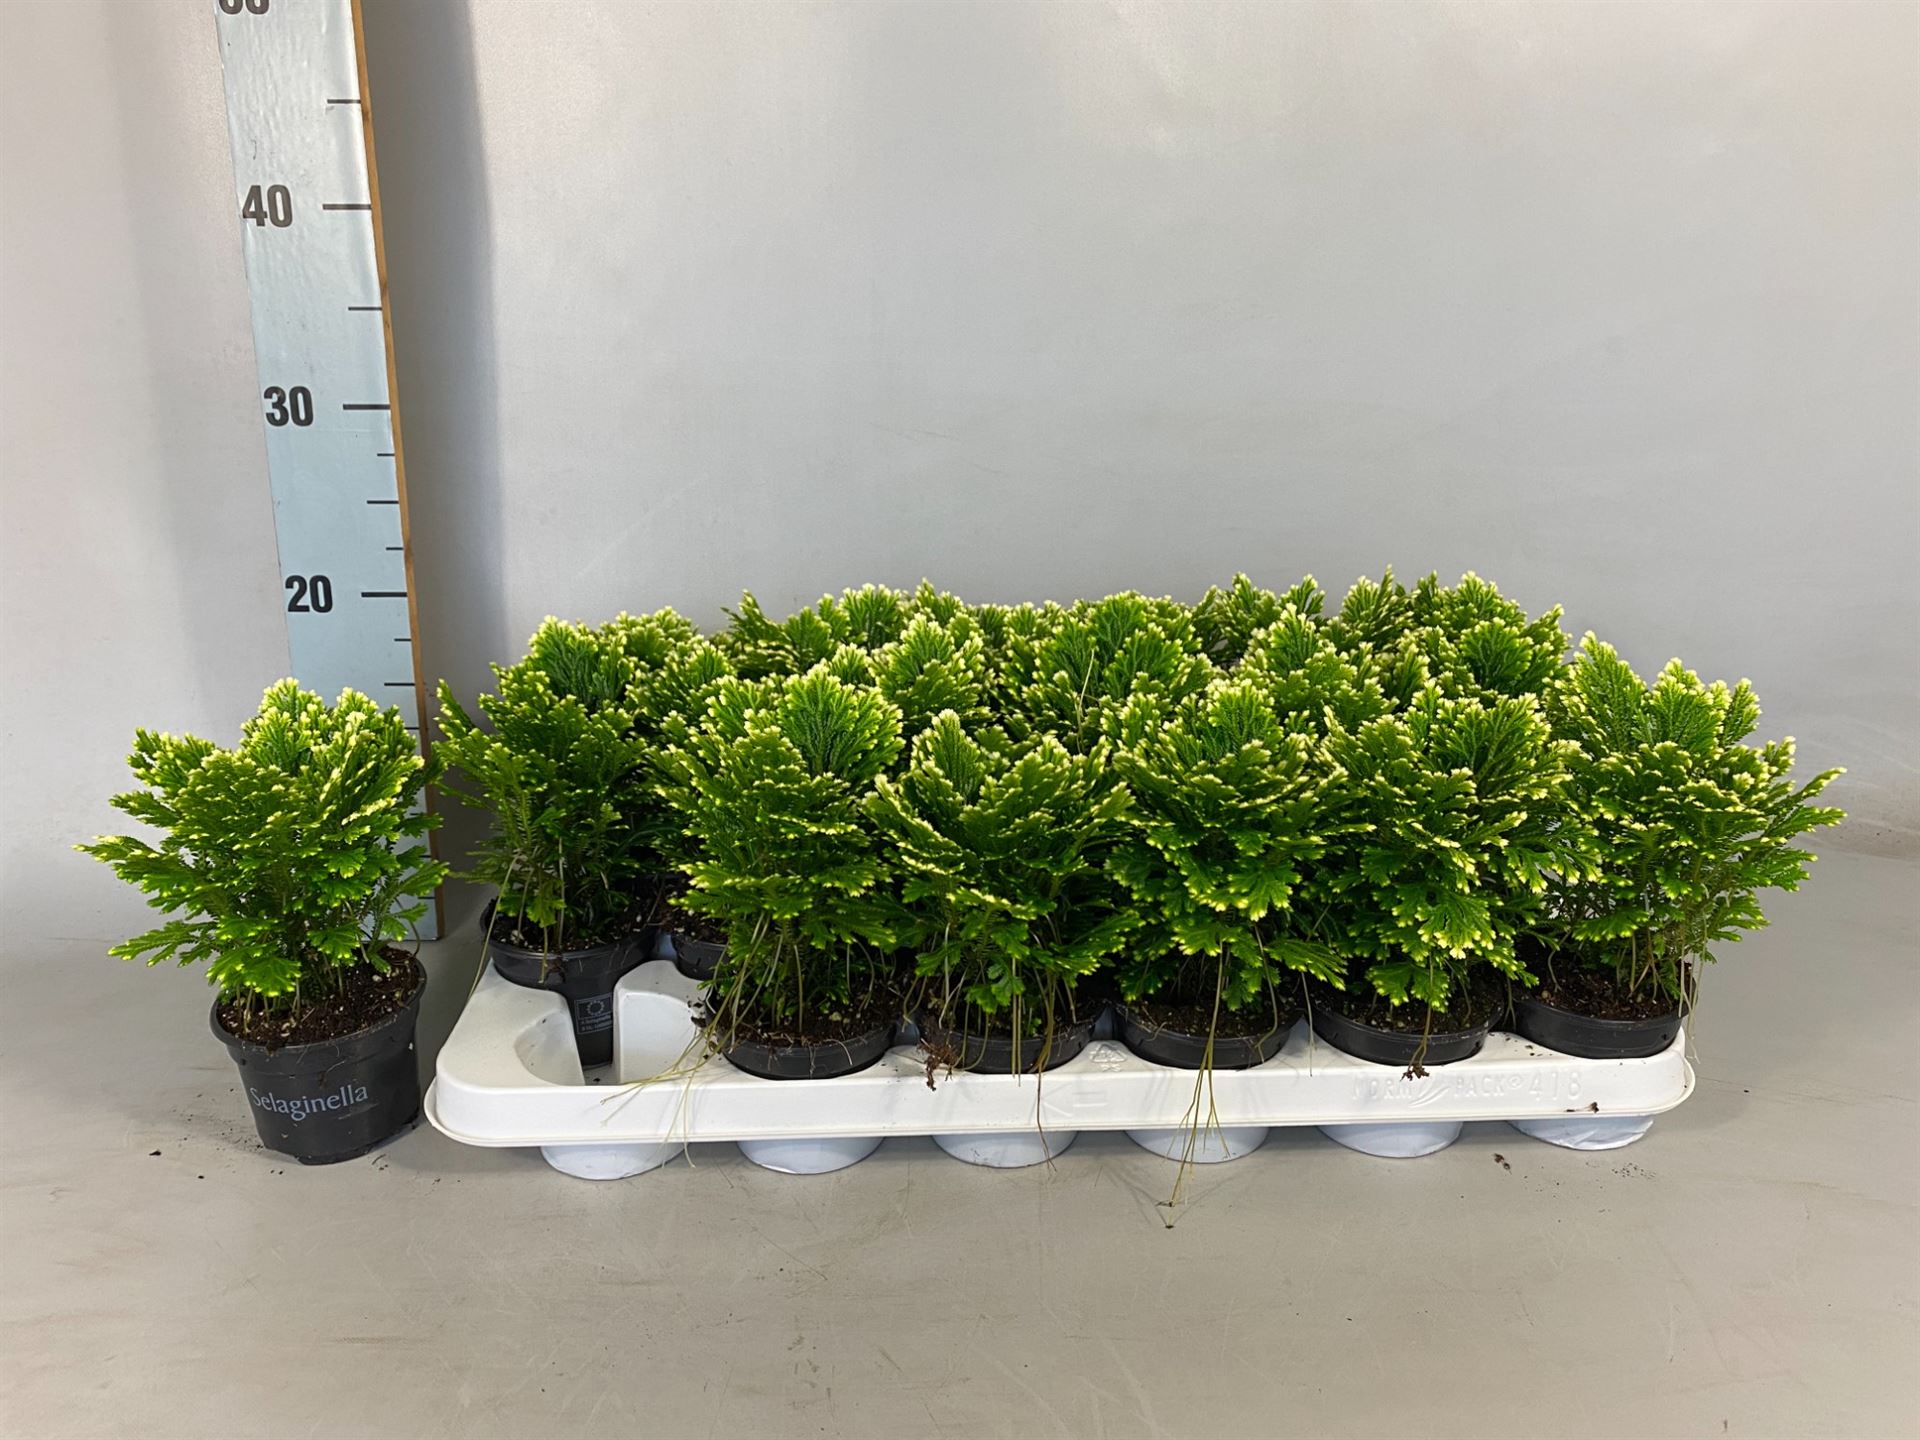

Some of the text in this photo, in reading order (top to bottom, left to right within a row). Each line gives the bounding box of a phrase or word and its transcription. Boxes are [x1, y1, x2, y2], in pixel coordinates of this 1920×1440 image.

[242, 184, 293, 228] 40
[263, 386, 314, 427] 30
[285, 574, 333, 613] 20
[249, 1084, 369, 1121] Selaginella
[1528, 1070, 1582, 1101] 418
